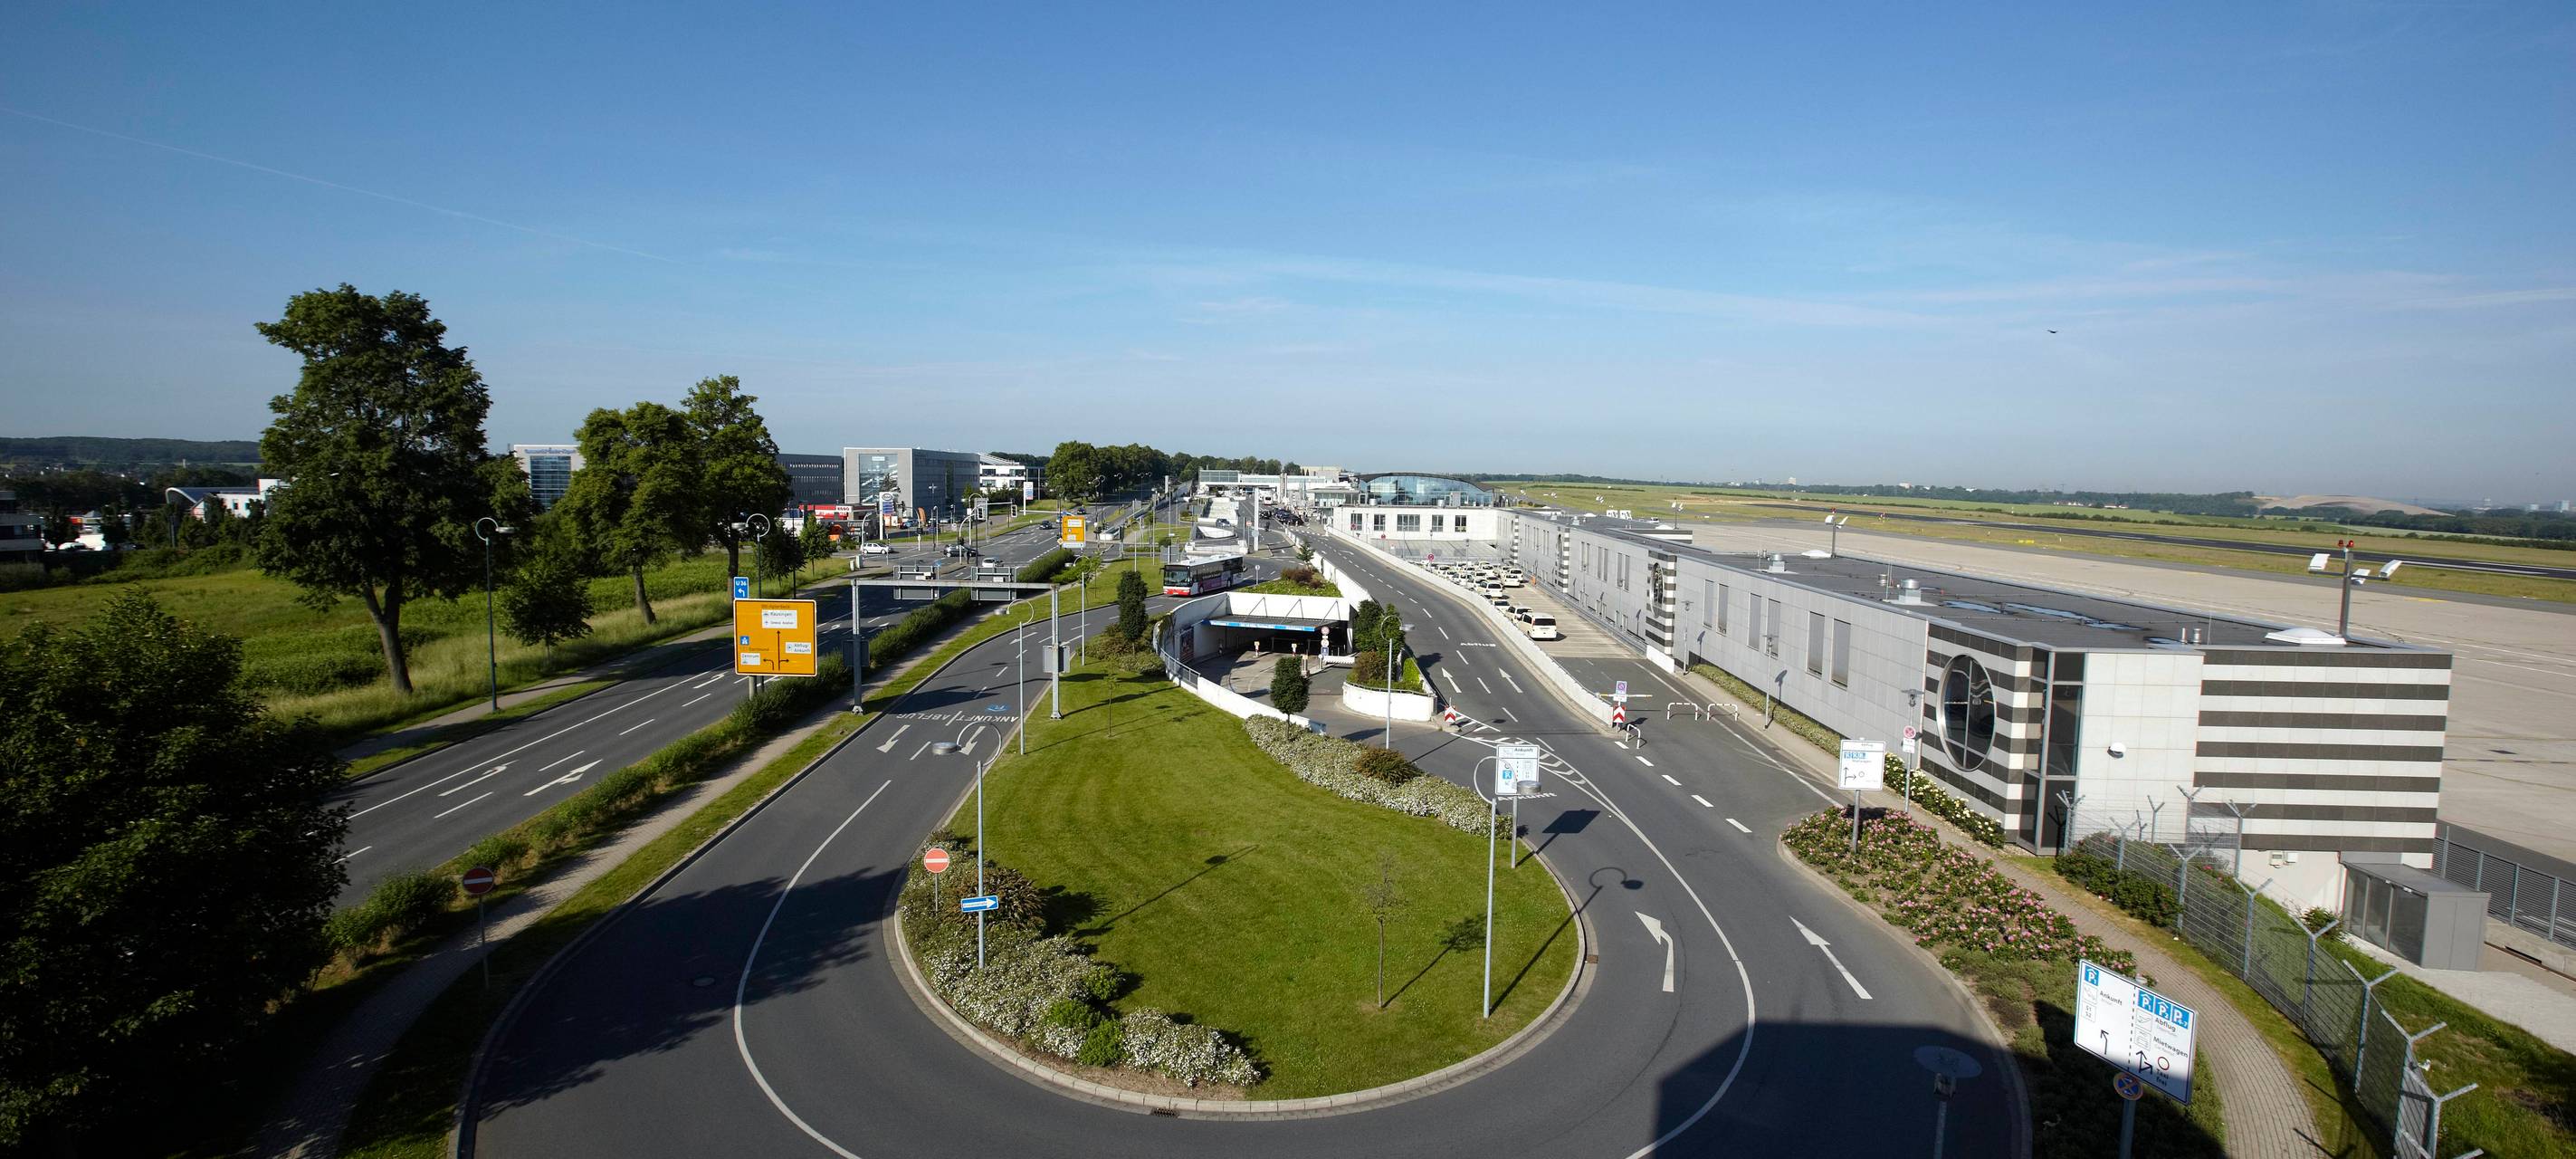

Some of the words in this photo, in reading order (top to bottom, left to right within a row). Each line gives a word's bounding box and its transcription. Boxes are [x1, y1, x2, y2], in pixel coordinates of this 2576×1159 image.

[2100, 990, 2123, 1006] Ankunft
[2155, 1017, 2176, 1032] Abflug
[2153, 1036, 2189, 1058] Mietwagen
